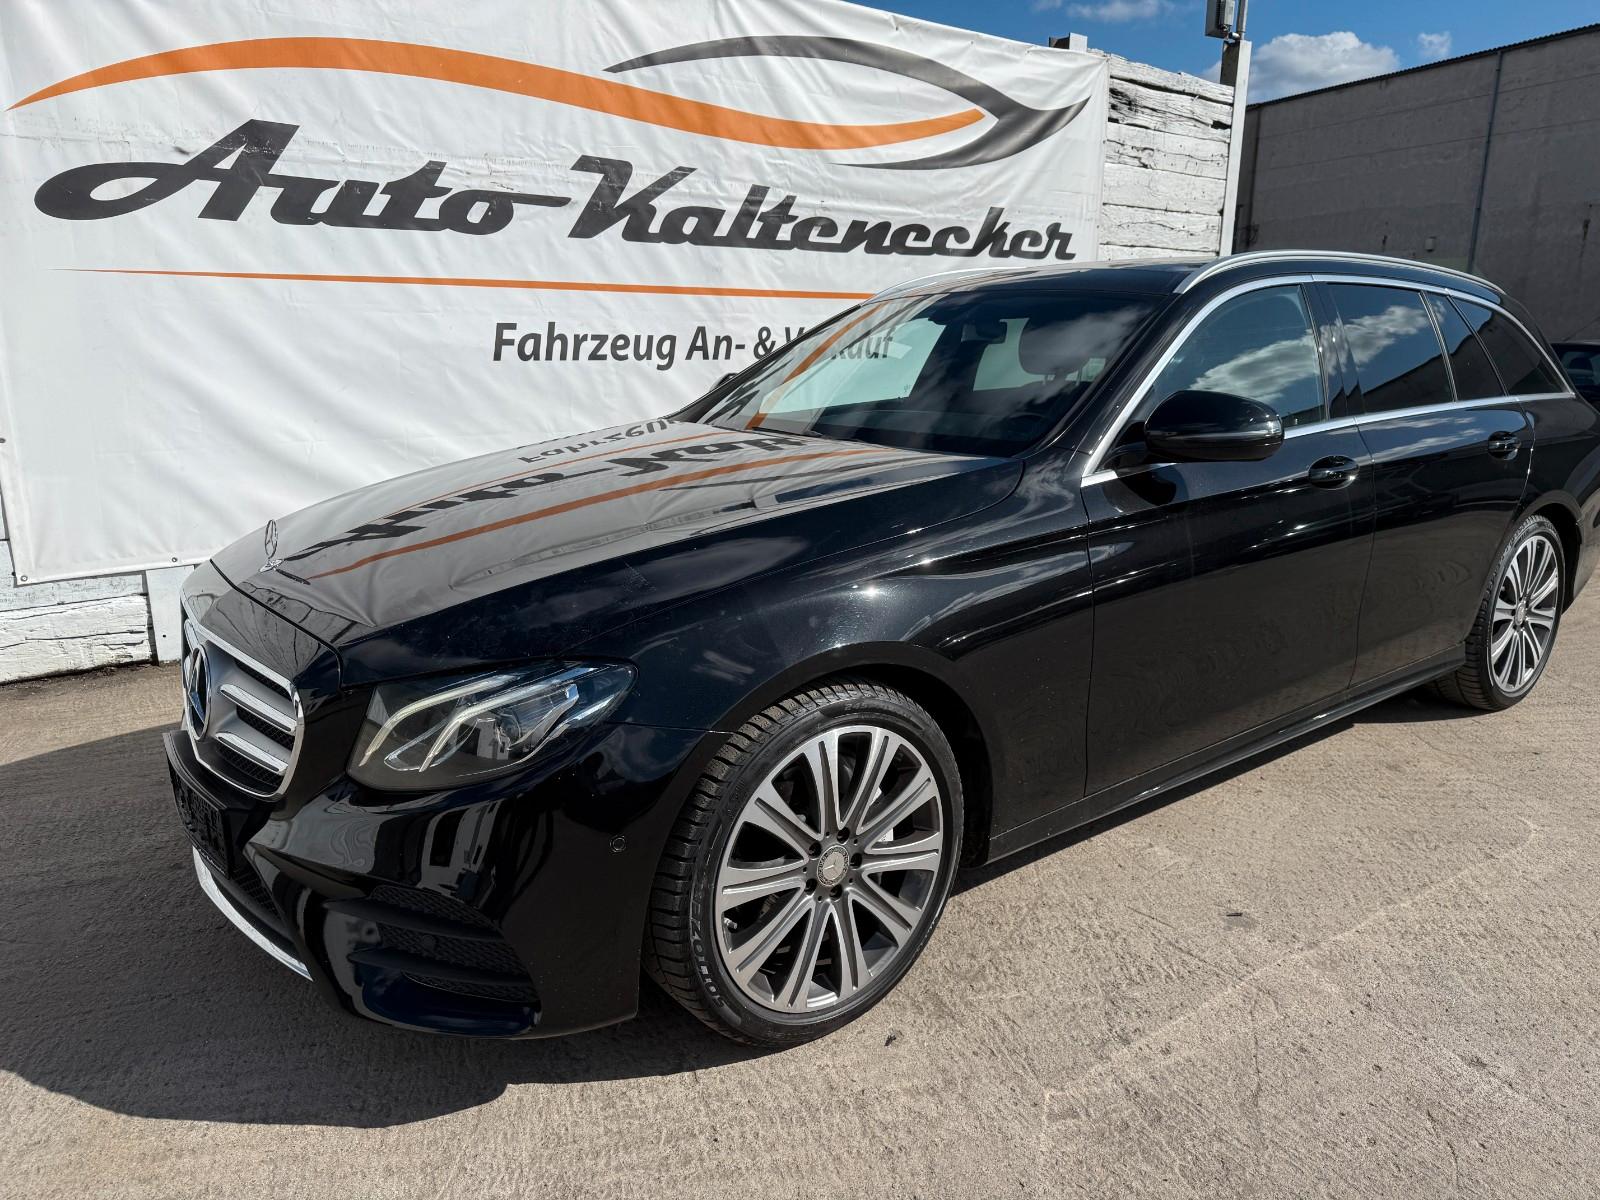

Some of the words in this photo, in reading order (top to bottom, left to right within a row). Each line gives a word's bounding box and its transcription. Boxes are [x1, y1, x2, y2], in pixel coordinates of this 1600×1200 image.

[493, 321, 677, 371] Fahrzeug
[685, 325, 746, 361] An-
[753, 325, 776, 361] &
